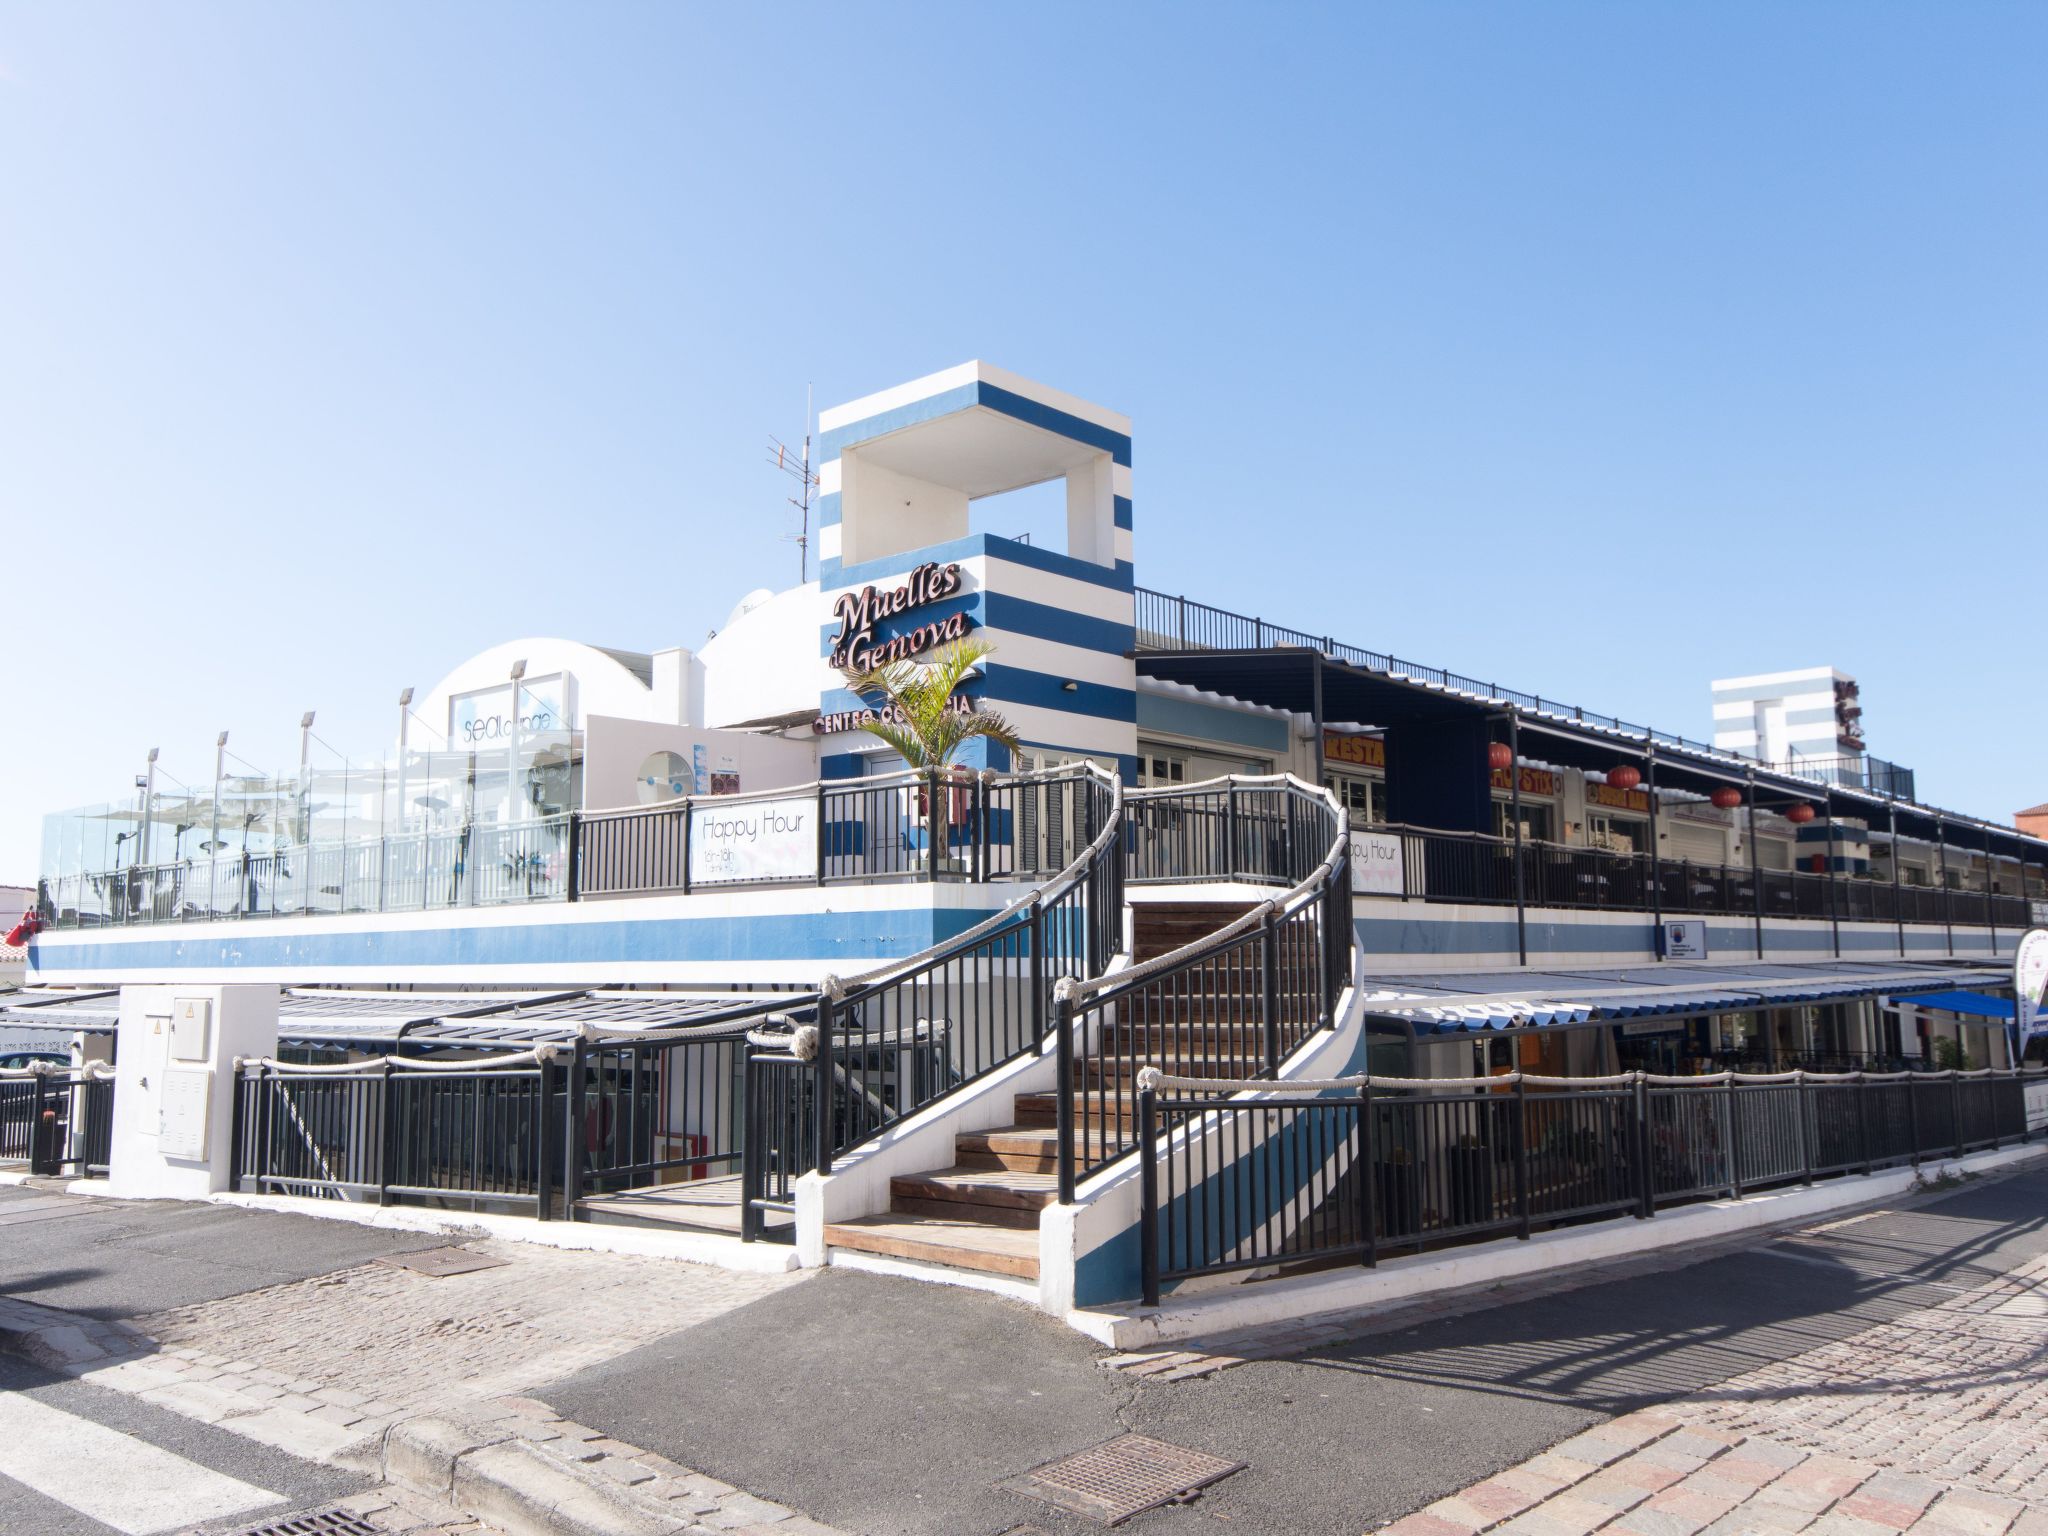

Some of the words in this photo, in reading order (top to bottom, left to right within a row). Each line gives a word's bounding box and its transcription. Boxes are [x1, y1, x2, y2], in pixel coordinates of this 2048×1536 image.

[828, 562, 961, 644] Muelles
[829, 644, 846, 669] de
[847, 612, 967, 675] Genova
[703, 815, 757, 844] Happy
[763, 809, 804, 835] Hour
[1371, 840, 1396, 861] Hour
